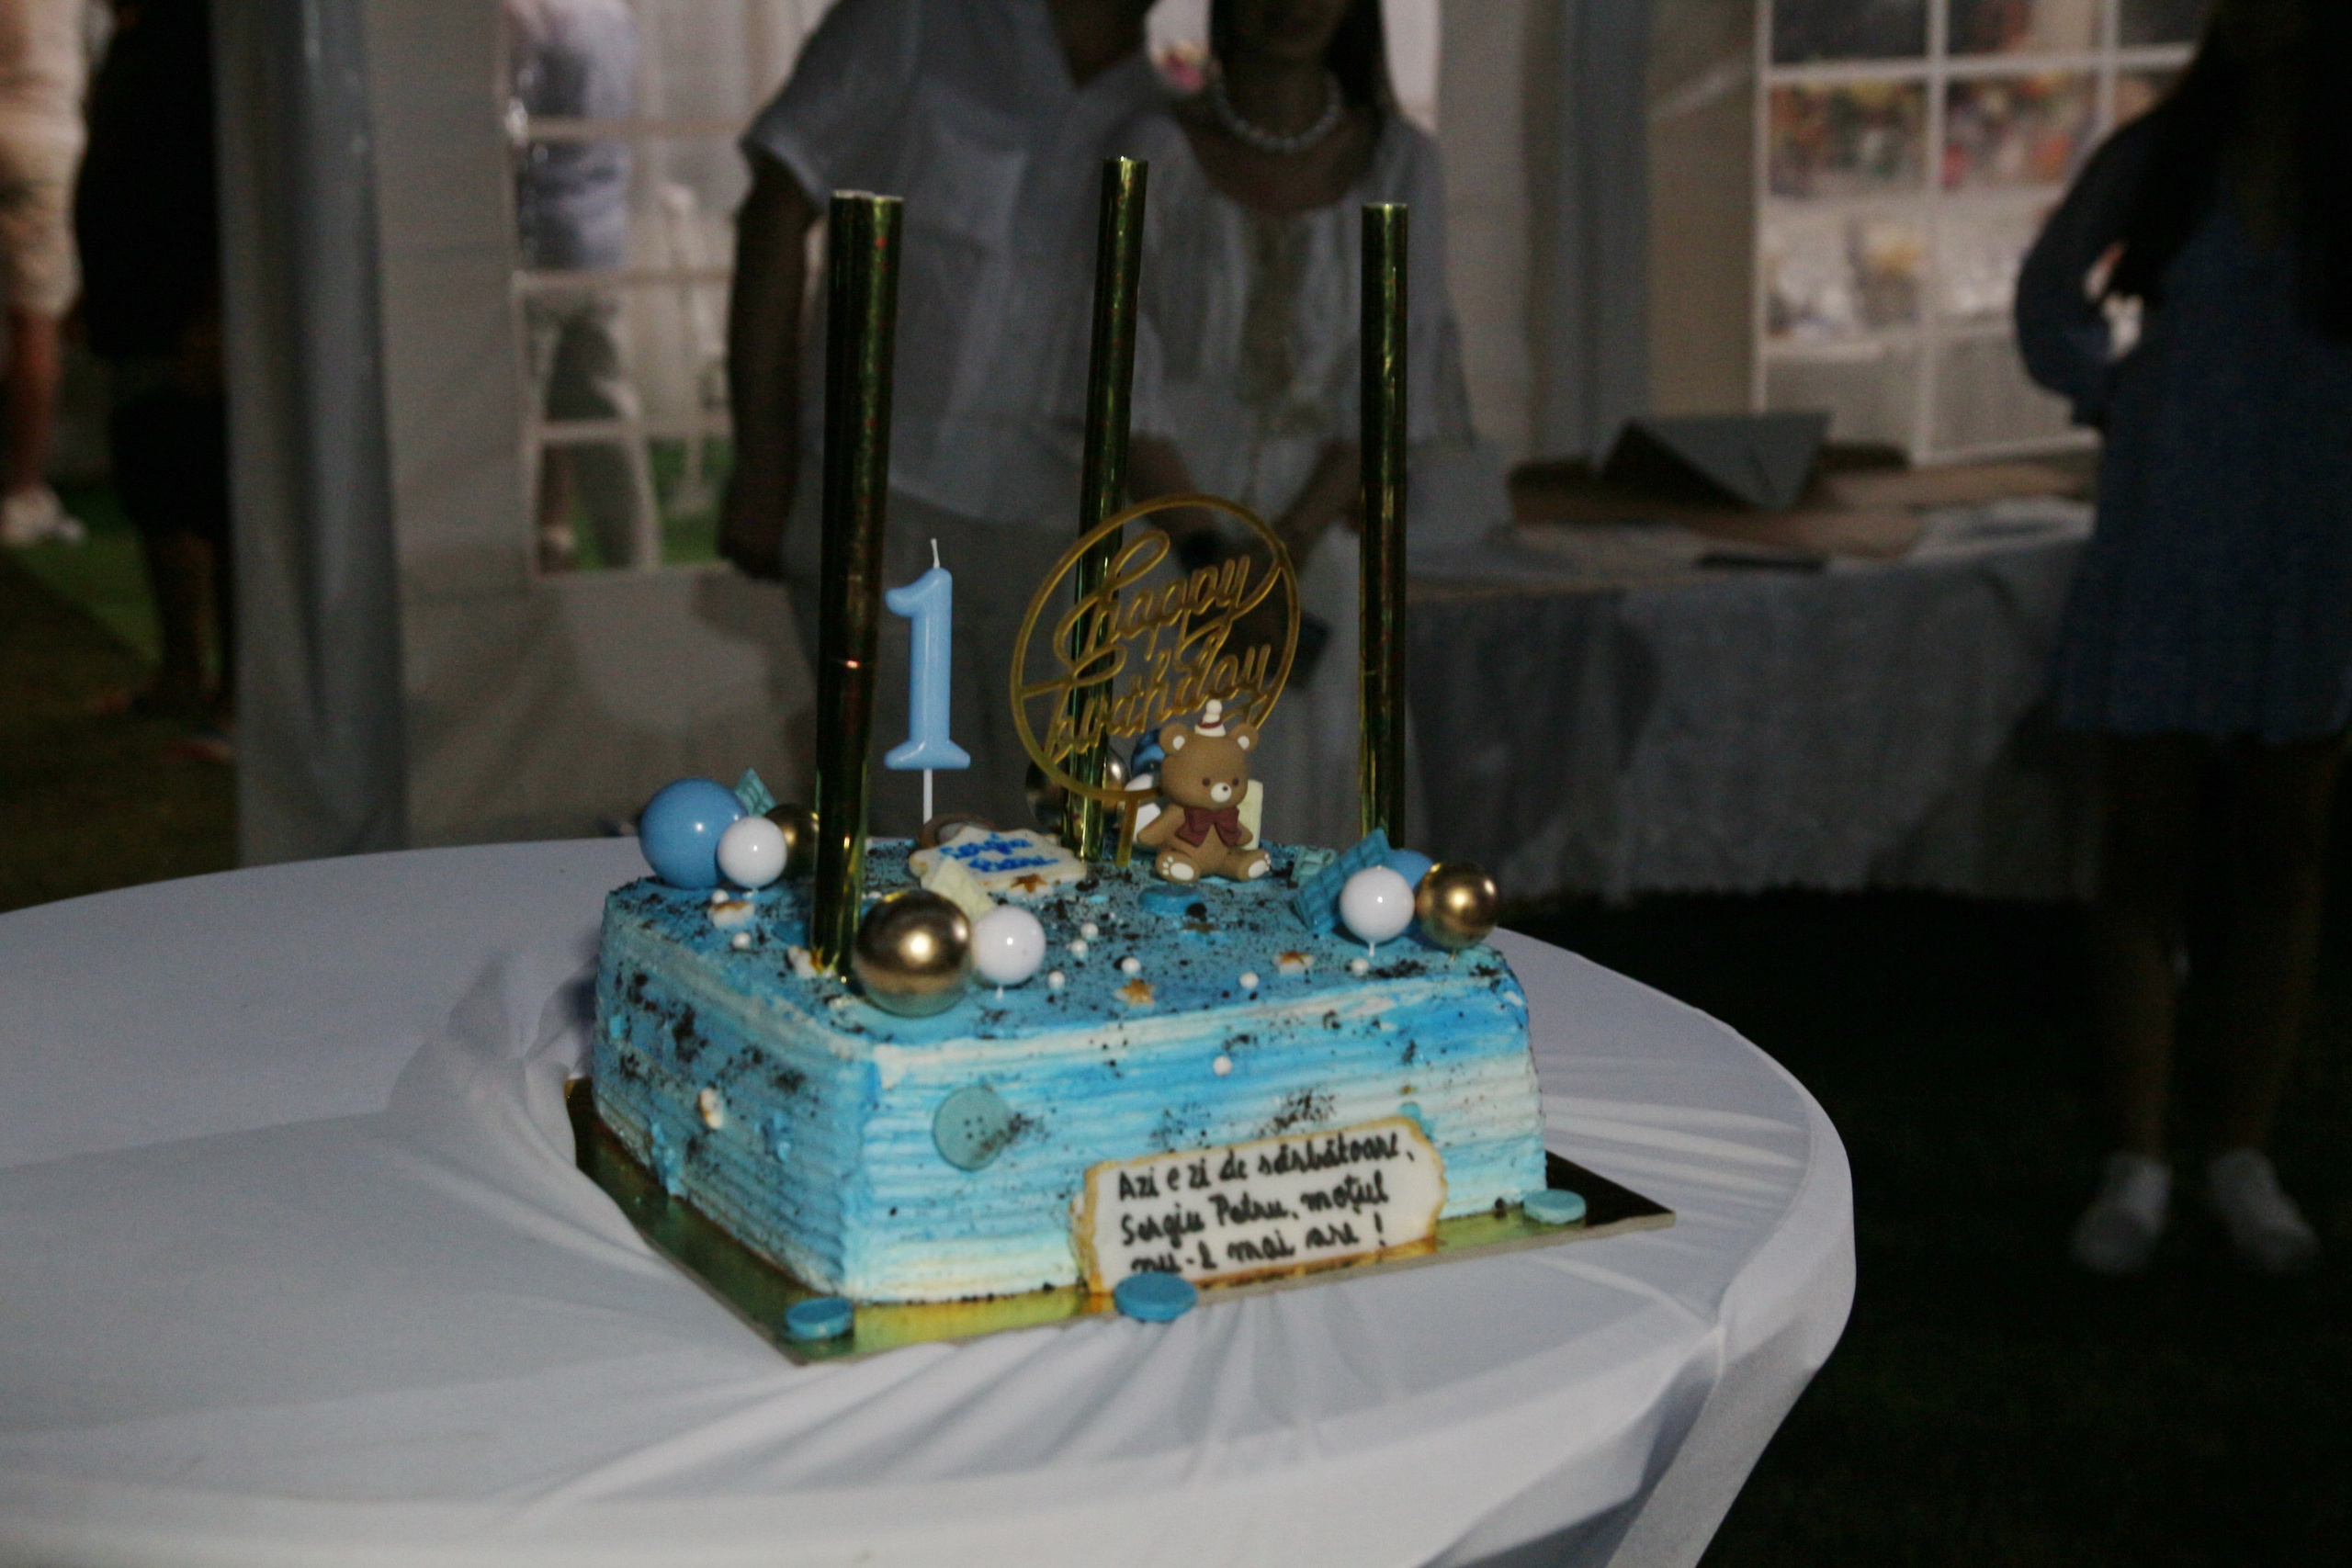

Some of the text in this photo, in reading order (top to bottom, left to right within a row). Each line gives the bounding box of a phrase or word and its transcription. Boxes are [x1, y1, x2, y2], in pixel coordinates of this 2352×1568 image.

[884, 567, 971, 770] 1
[1117, 1168, 1160, 1201] Azi
[1167, 1168, 1181, 1191] e
[1188, 1159, 1212, 1190] zi
[1219, 1147, 1249, 1181] de
[1121, 1201, 1205, 1249] Sergiu
[1227, 1228, 1296, 1262] mai
